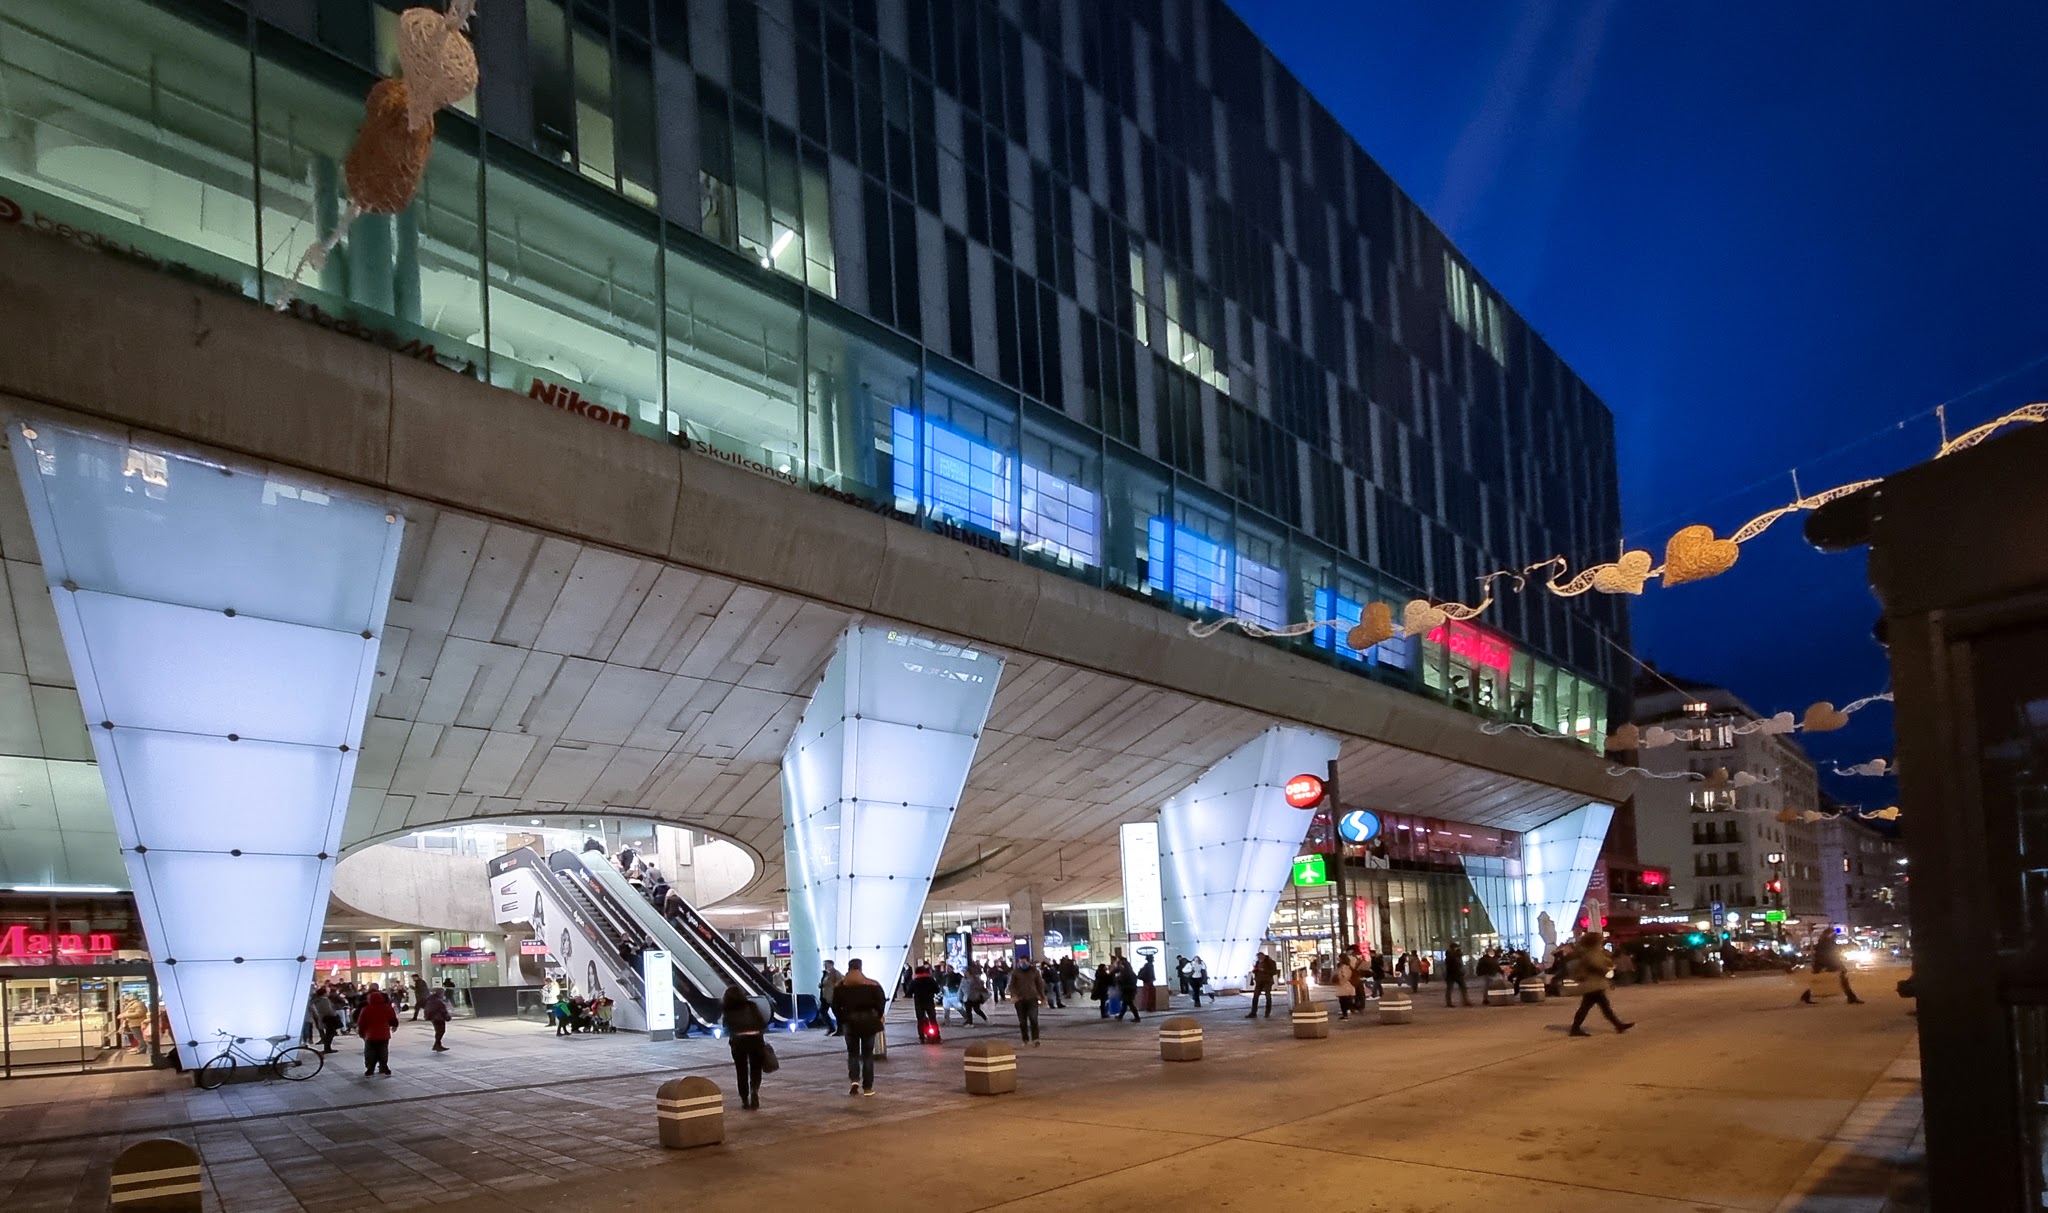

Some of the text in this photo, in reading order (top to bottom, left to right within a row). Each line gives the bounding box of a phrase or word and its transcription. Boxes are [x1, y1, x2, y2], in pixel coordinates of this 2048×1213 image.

[529, 378, 630, 431] Nikon
[696, 441, 798, 485] Skullcandy
[935, 521, 1012, 557] SIEMENS
